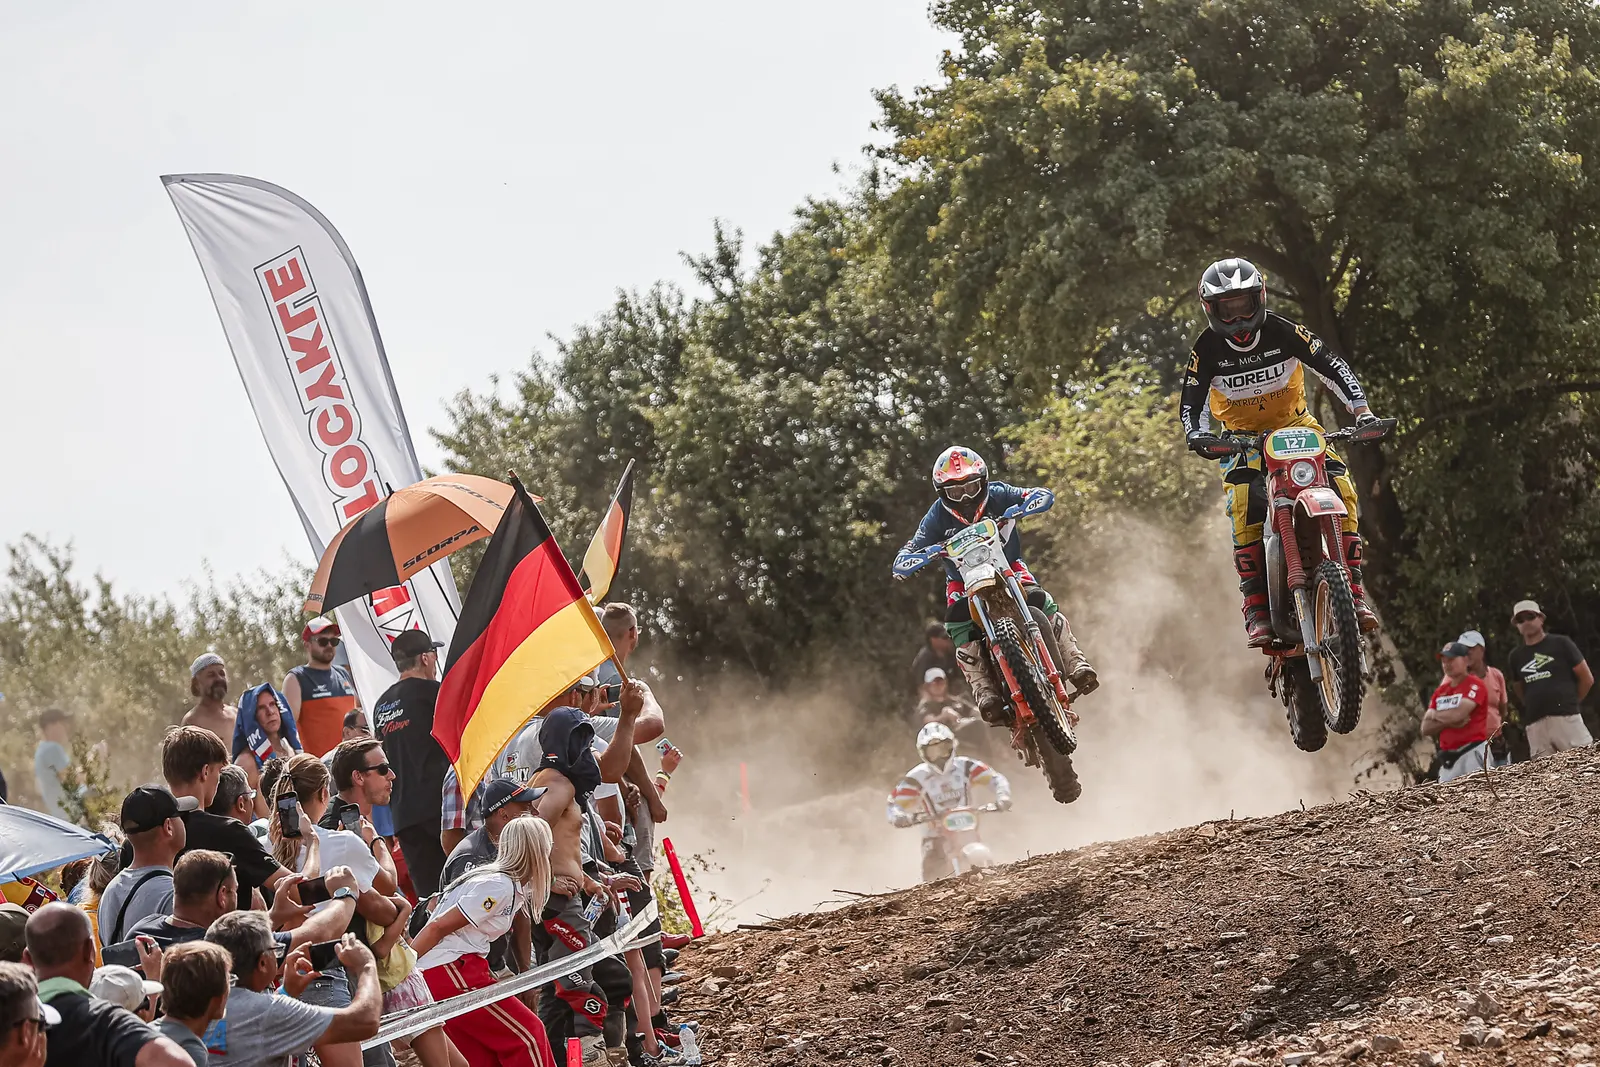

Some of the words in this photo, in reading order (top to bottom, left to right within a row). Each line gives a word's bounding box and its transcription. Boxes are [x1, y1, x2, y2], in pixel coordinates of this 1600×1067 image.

[1226, 396, 1268, 407] PATRIZIA
[1284, 437, 1307, 449] 127
[402, 525, 480, 571] SCORPA
[501, 794, 512, 804] TEAM
